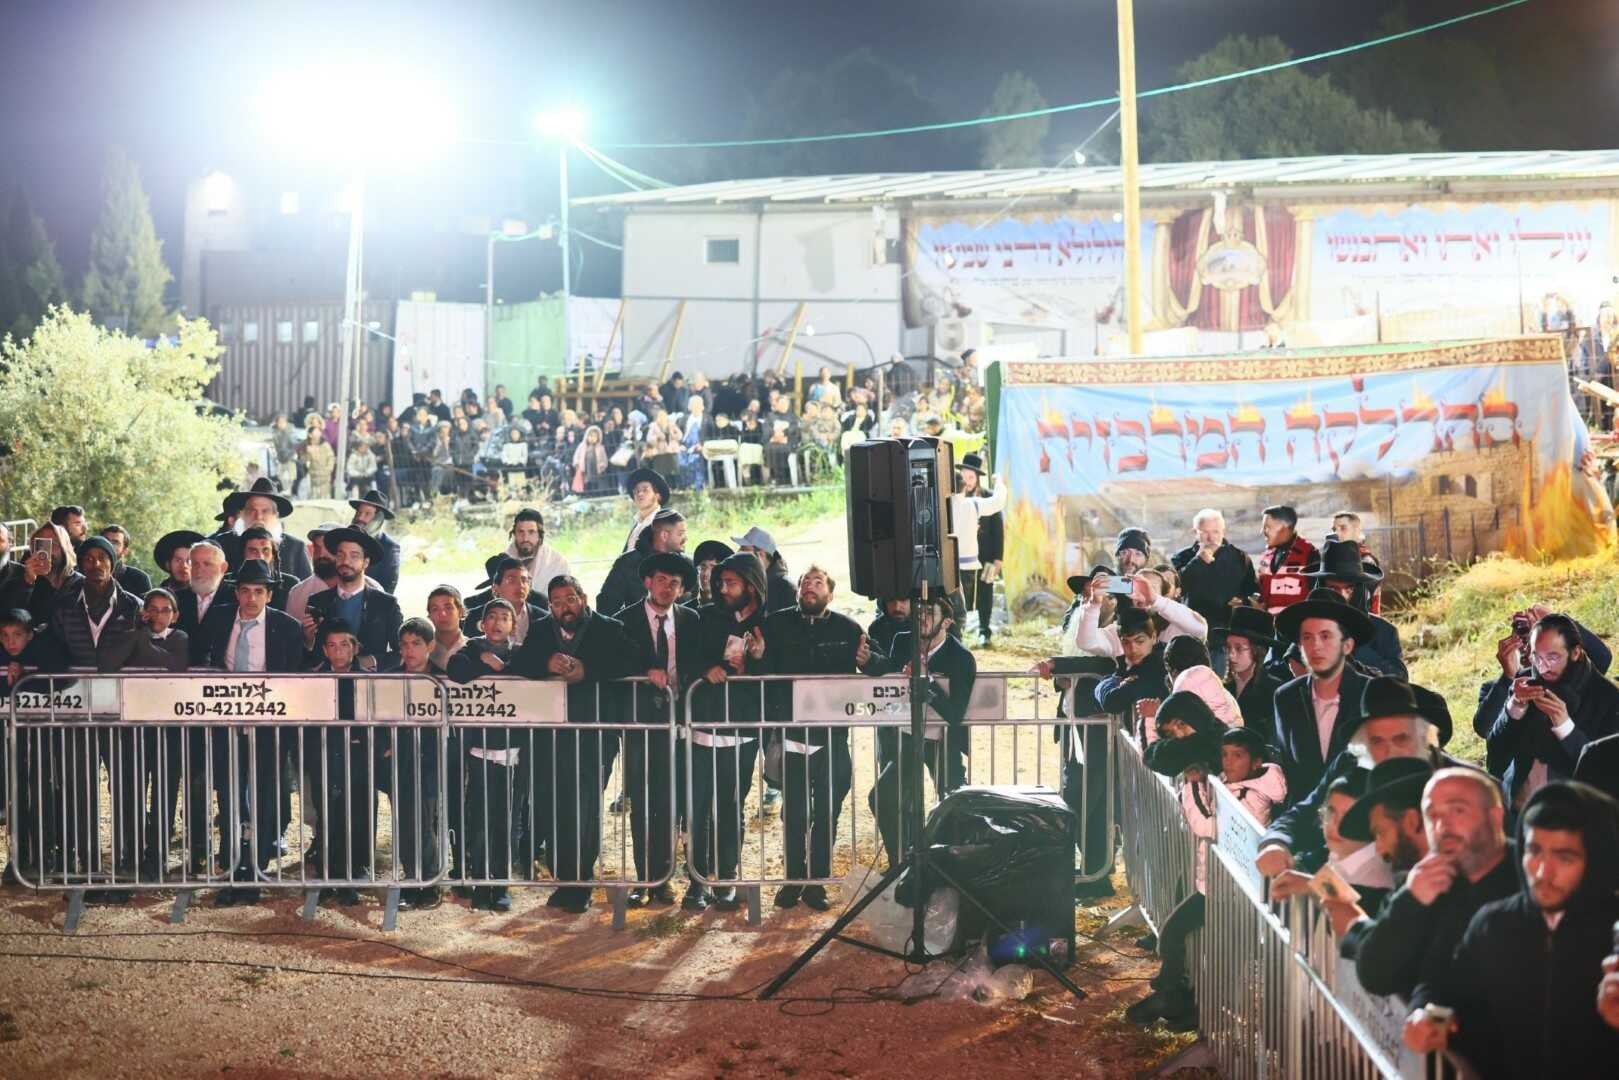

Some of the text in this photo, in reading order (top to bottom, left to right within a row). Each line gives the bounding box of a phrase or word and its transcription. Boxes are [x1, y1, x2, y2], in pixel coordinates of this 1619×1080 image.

[1036, 378, 1523, 474] ההדלקה המרכזית
[203, 682, 253, 699] להבים
[174, 702, 286, 716] 050-4212442
[407, 703, 517, 717] 050-4212442
